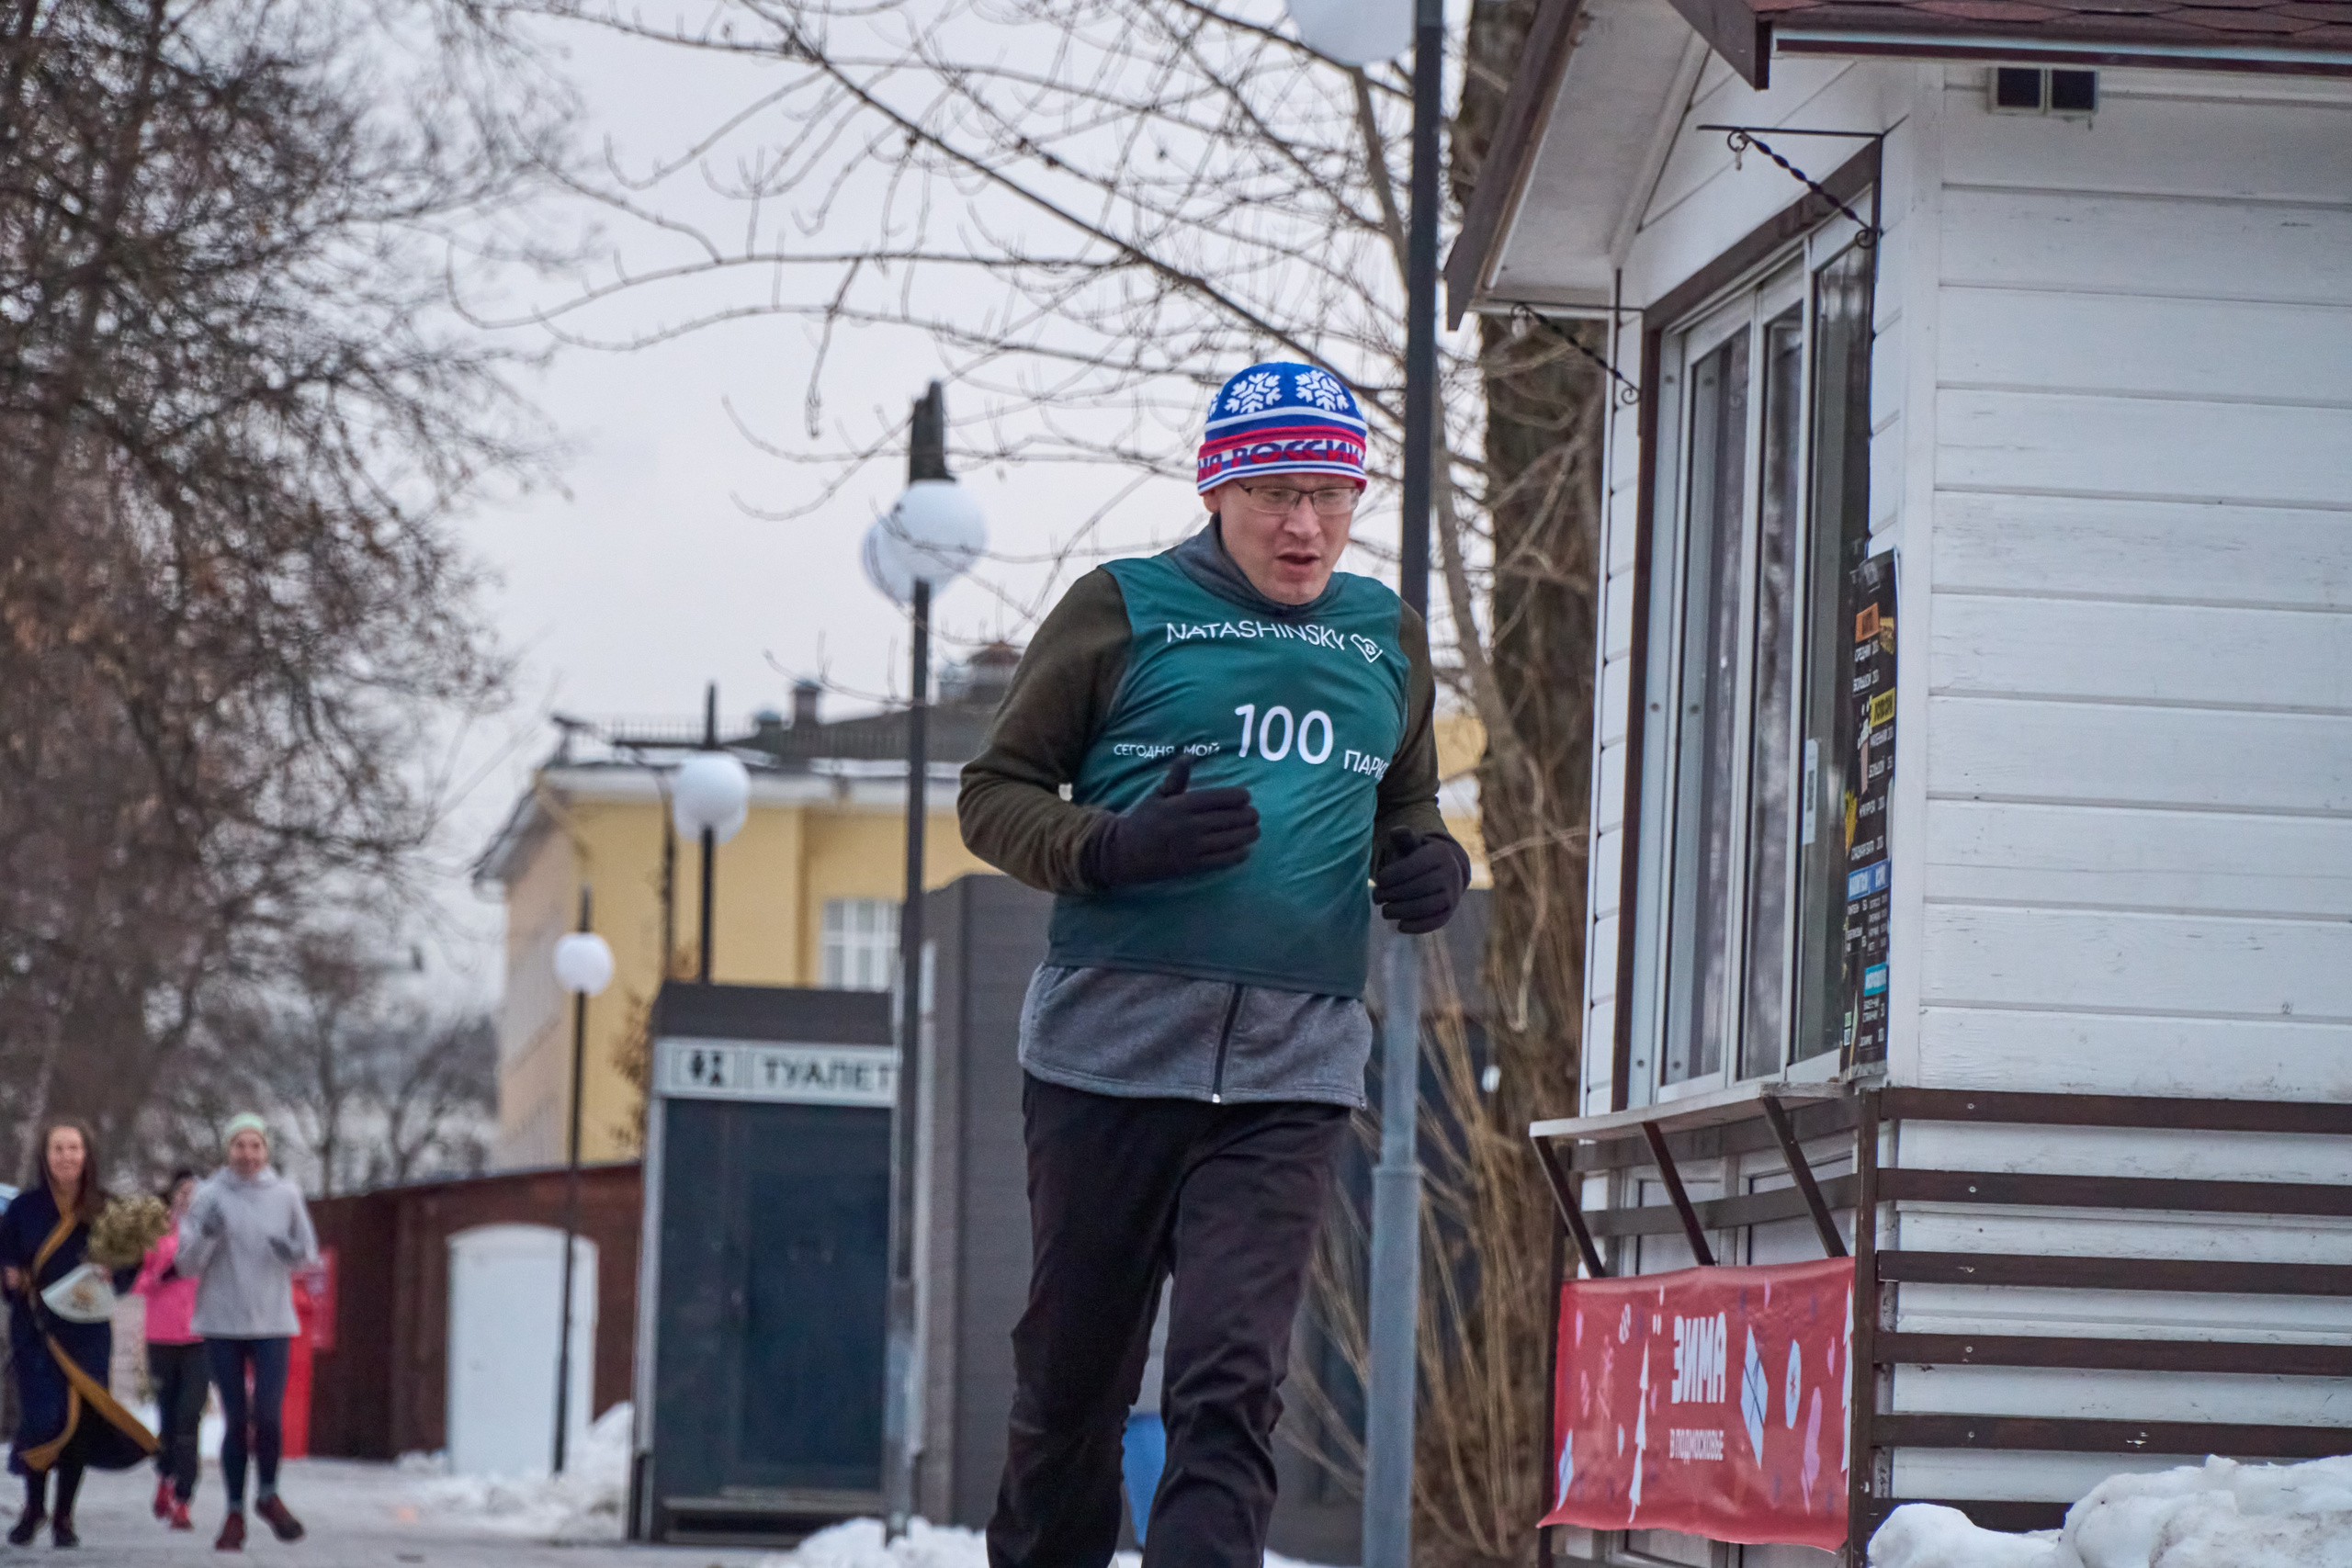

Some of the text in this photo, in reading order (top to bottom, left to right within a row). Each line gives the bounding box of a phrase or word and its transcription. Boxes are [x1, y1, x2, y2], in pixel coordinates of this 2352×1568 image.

[1167, 620, 1345, 649] NATASHINSKY
[1114, 743, 1174, 759] СЕГОДНЯ
[1183, 742, 1220, 756] МОЙ
[1235, 704, 1334, 764] 100
[764, 1058, 892, 1091] ТУАЛЕТ
[1671, 1312, 1726, 1404] ЗИМА
